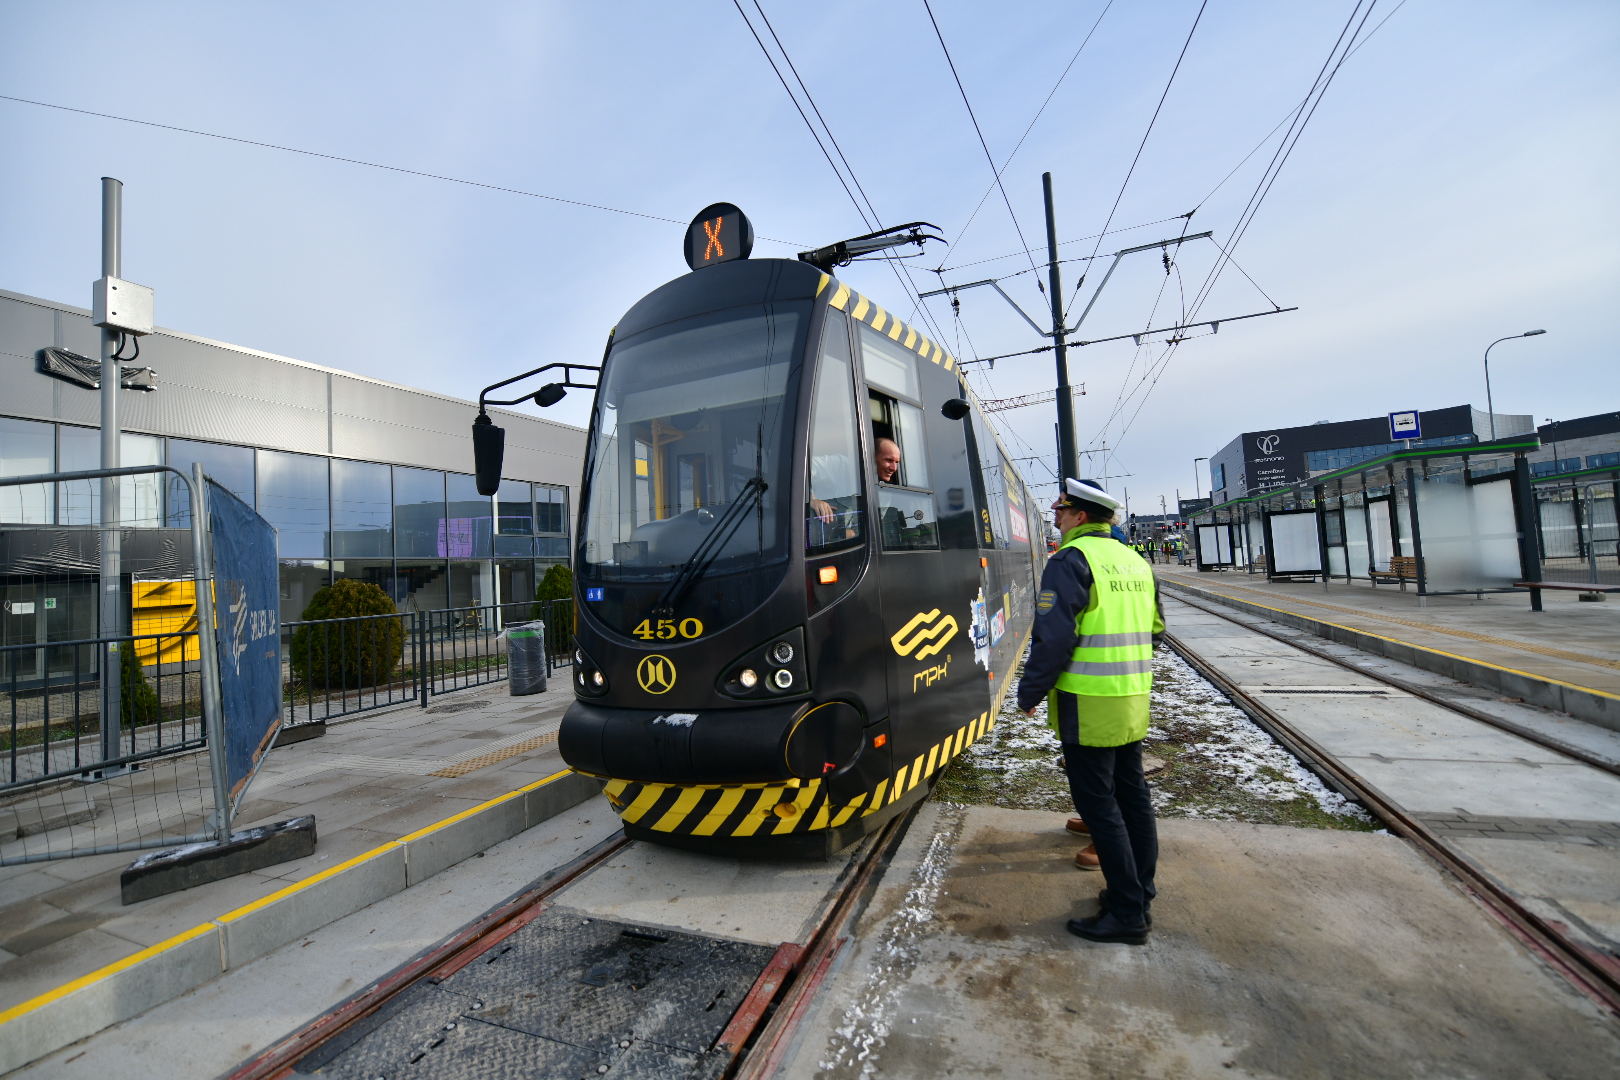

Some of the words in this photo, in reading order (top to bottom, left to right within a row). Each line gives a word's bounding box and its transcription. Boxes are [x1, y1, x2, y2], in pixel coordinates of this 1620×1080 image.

[703, 216, 724, 260] X
[1109, 580, 1147, 592] RUCHU
[632, 617, 704, 640] 450
